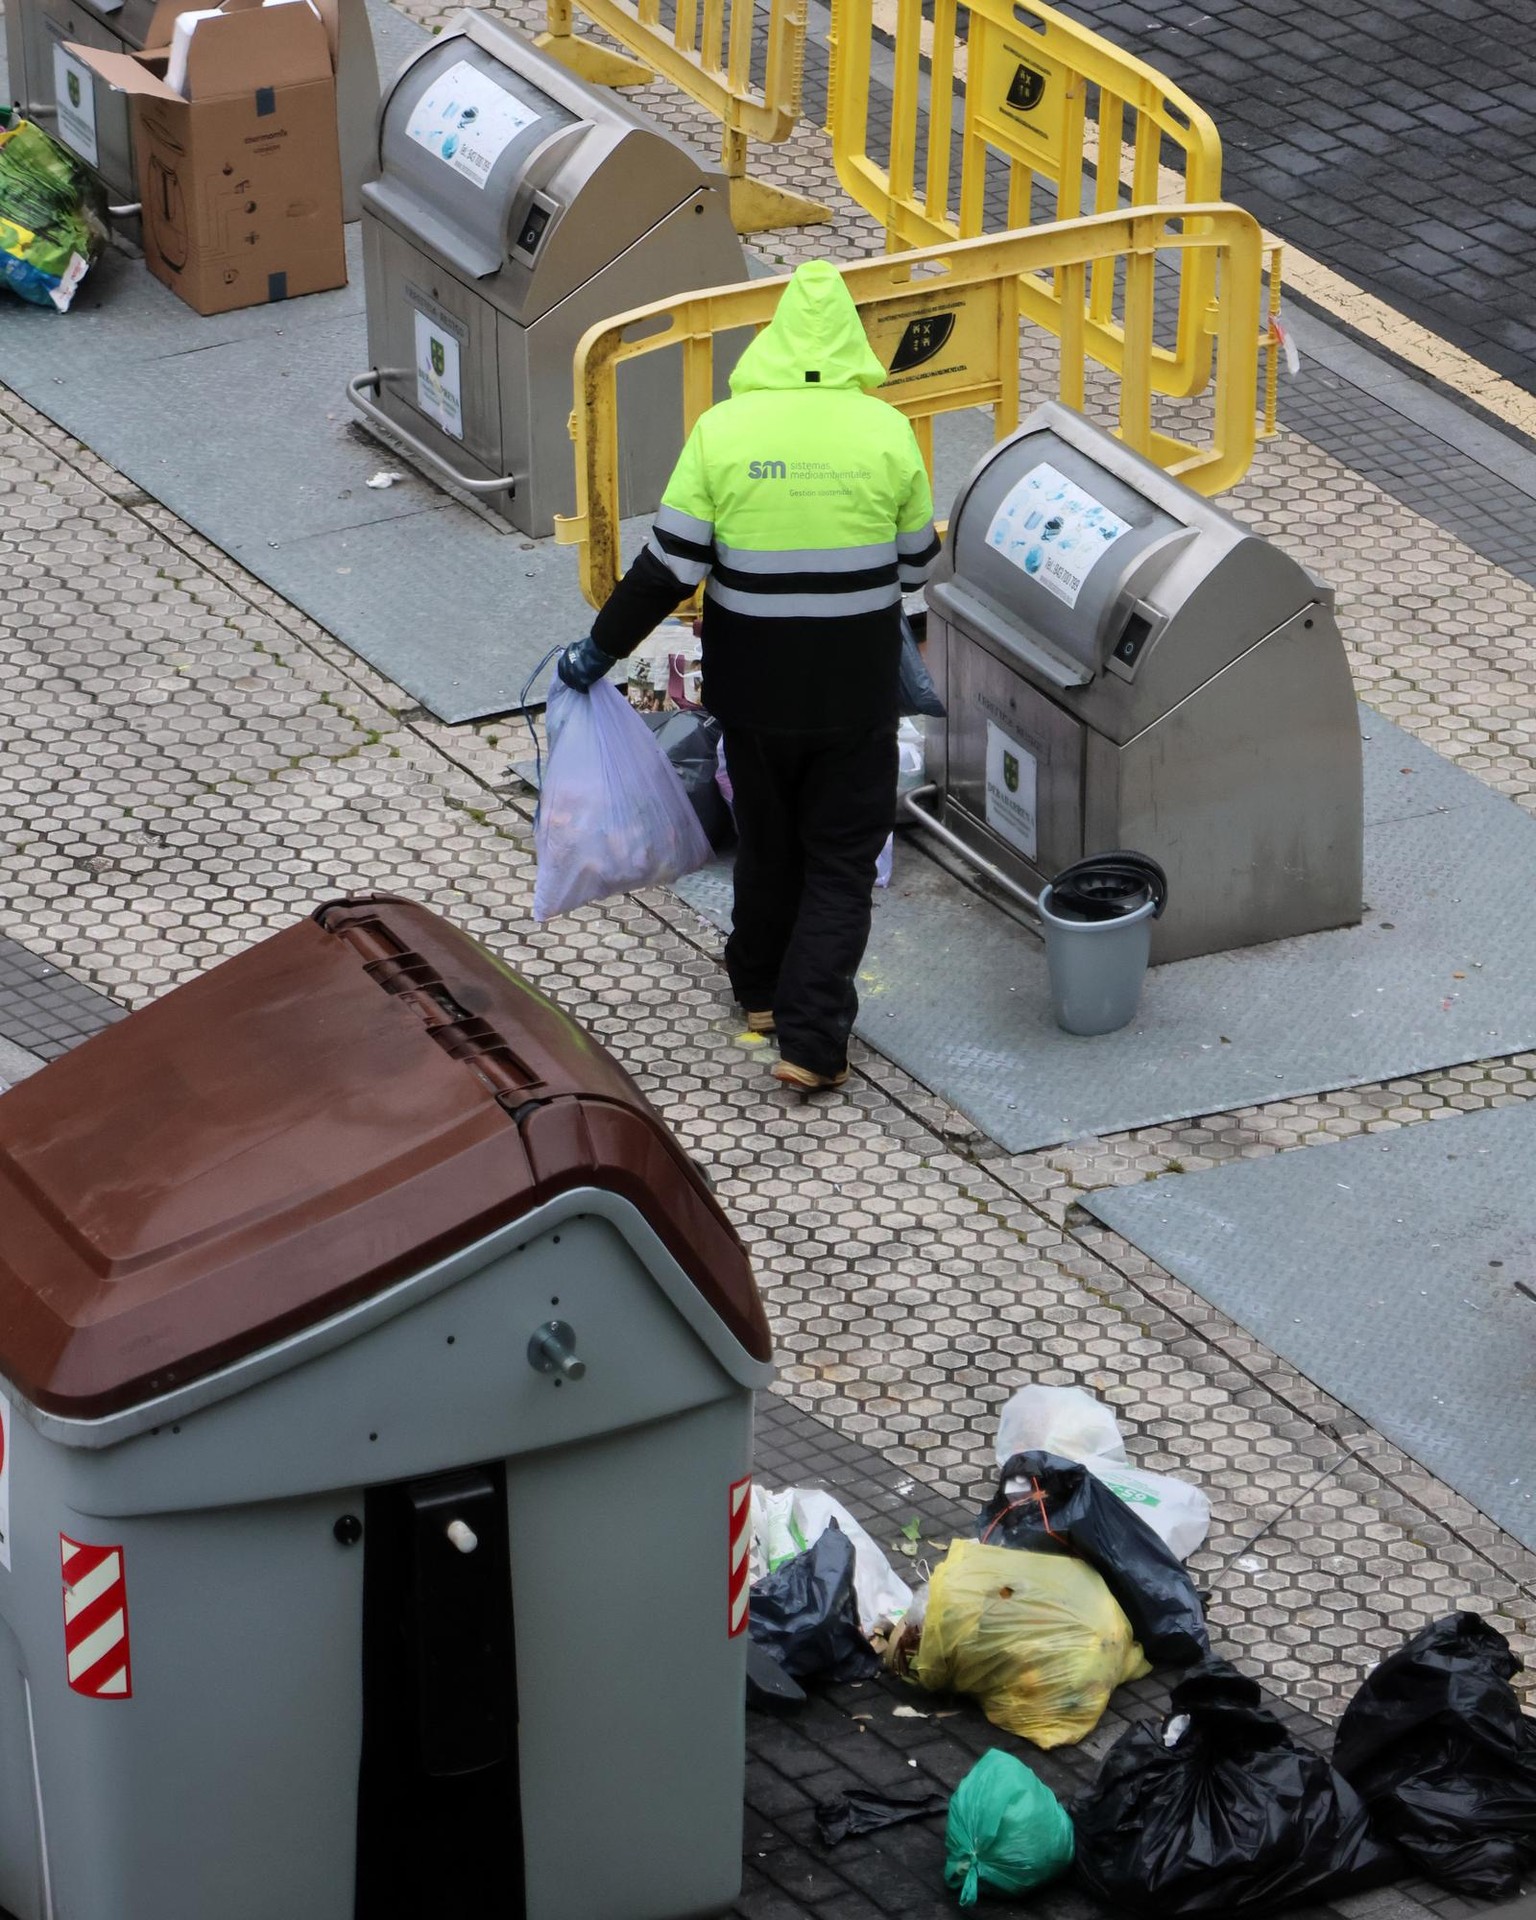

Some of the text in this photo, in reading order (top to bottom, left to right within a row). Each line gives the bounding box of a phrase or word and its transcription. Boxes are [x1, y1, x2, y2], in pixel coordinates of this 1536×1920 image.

[748, 460, 787, 479] sm
[790, 461, 831, 471] sistemas
[790, 469, 872, 481] medioambientales
